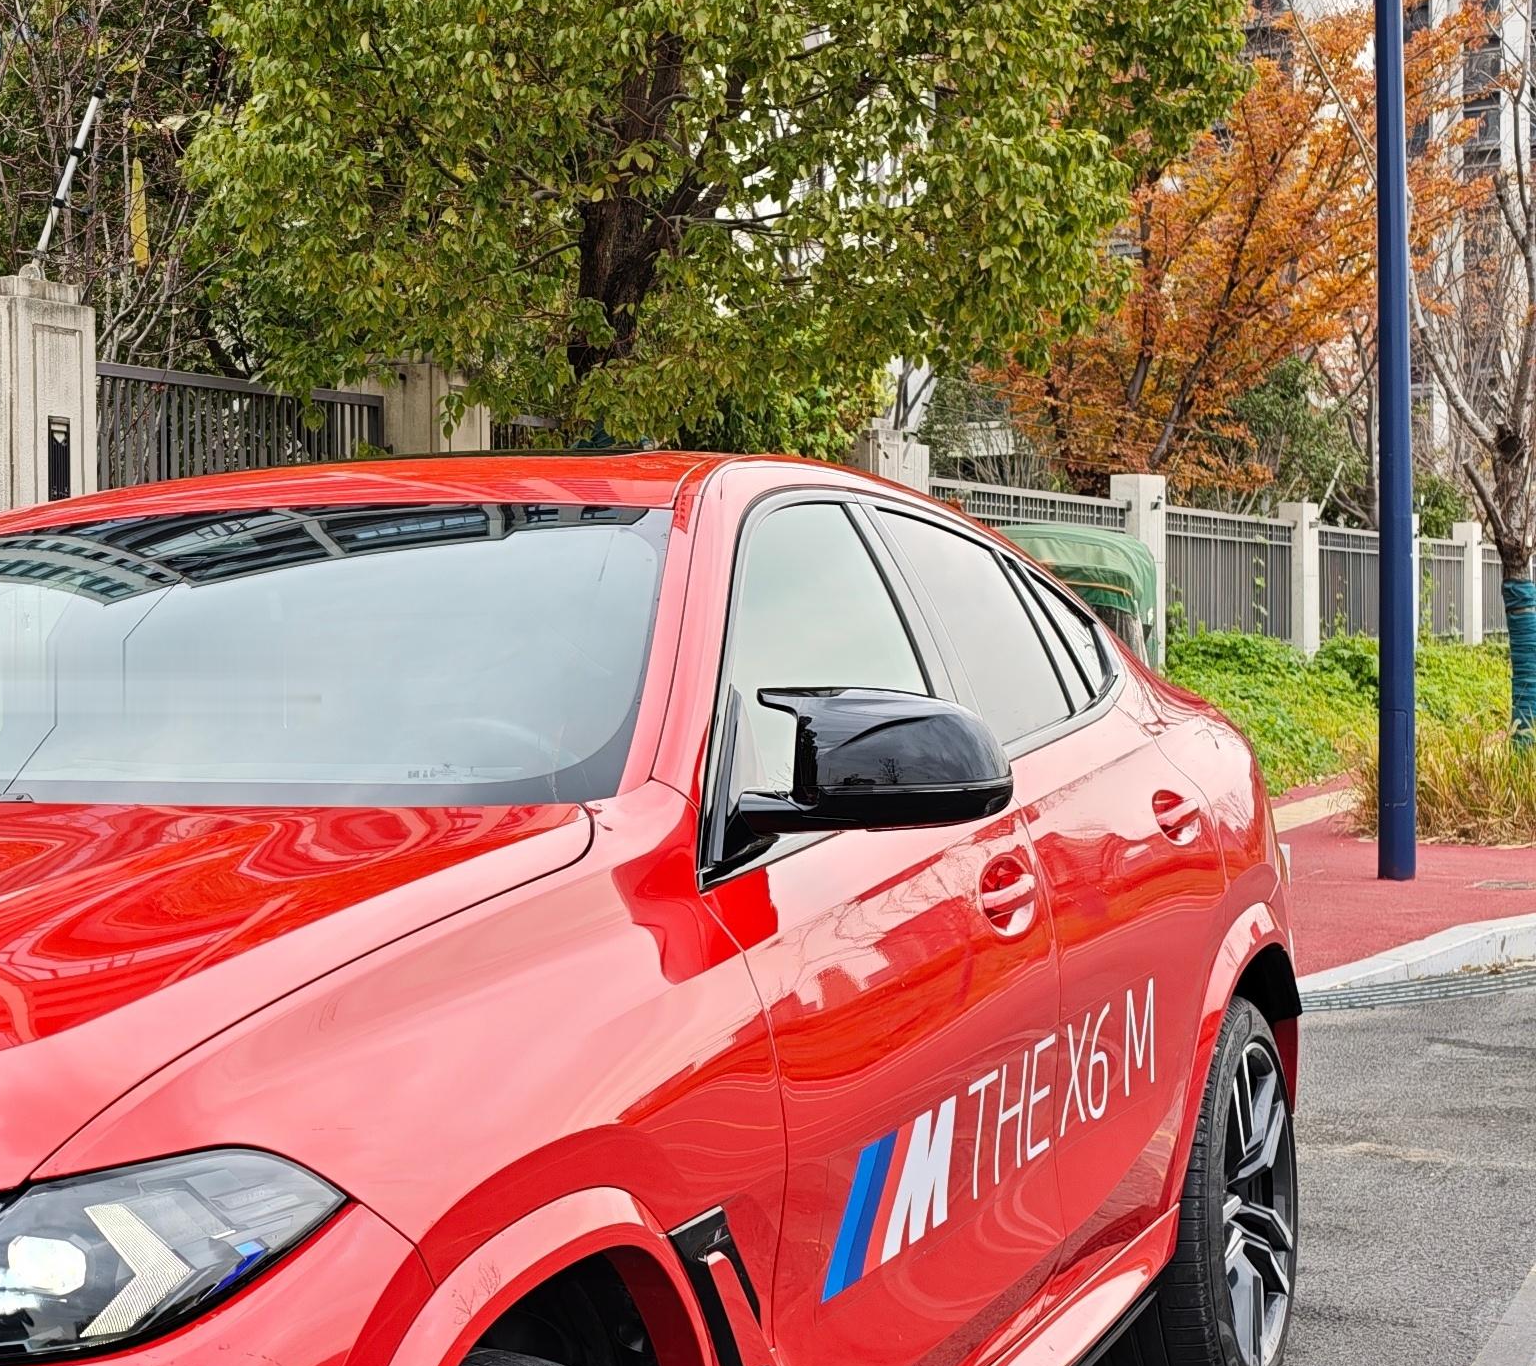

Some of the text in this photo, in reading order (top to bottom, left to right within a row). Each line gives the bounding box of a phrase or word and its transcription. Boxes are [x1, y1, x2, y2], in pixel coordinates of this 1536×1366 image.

[967, 1033, 1057, 1200] THE
[1059, 1002, 1112, 1138] X6
[1124, 977, 1156, 1097] M
